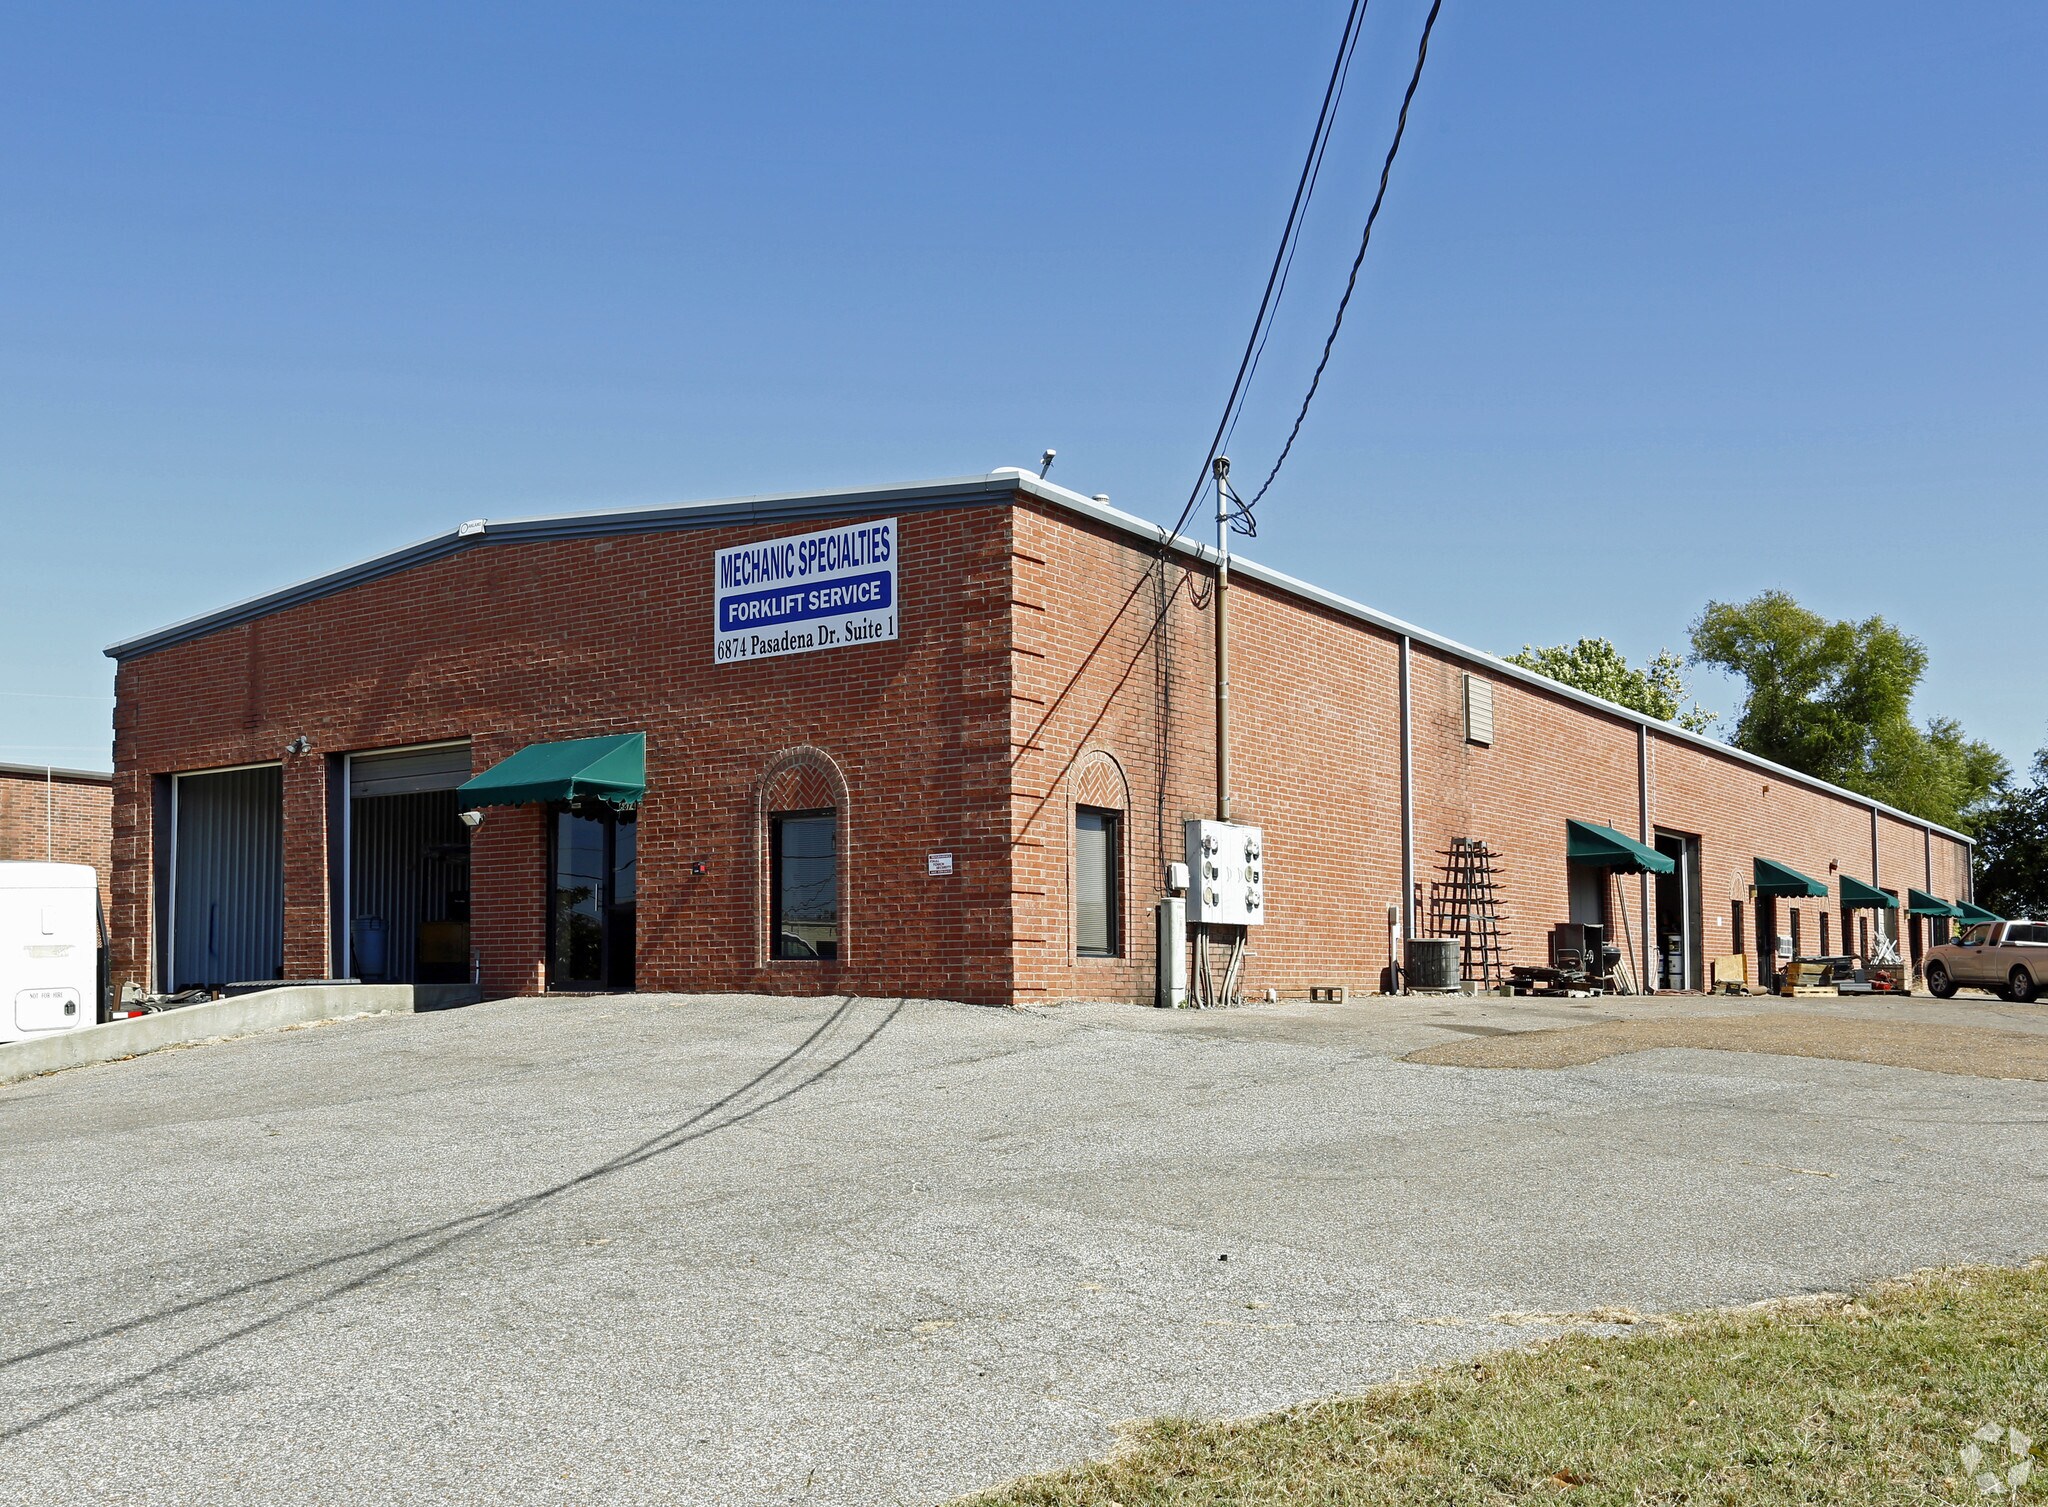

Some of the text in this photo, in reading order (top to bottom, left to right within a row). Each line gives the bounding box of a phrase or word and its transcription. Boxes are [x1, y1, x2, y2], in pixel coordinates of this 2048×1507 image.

[721, 526, 890, 589] MECHANIC SPECIALTIES
[728, 581, 881, 622] FORKLIFT SERVICE
[717, 615, 894, 660] 6874 Pasadena Dr. Suite 1
